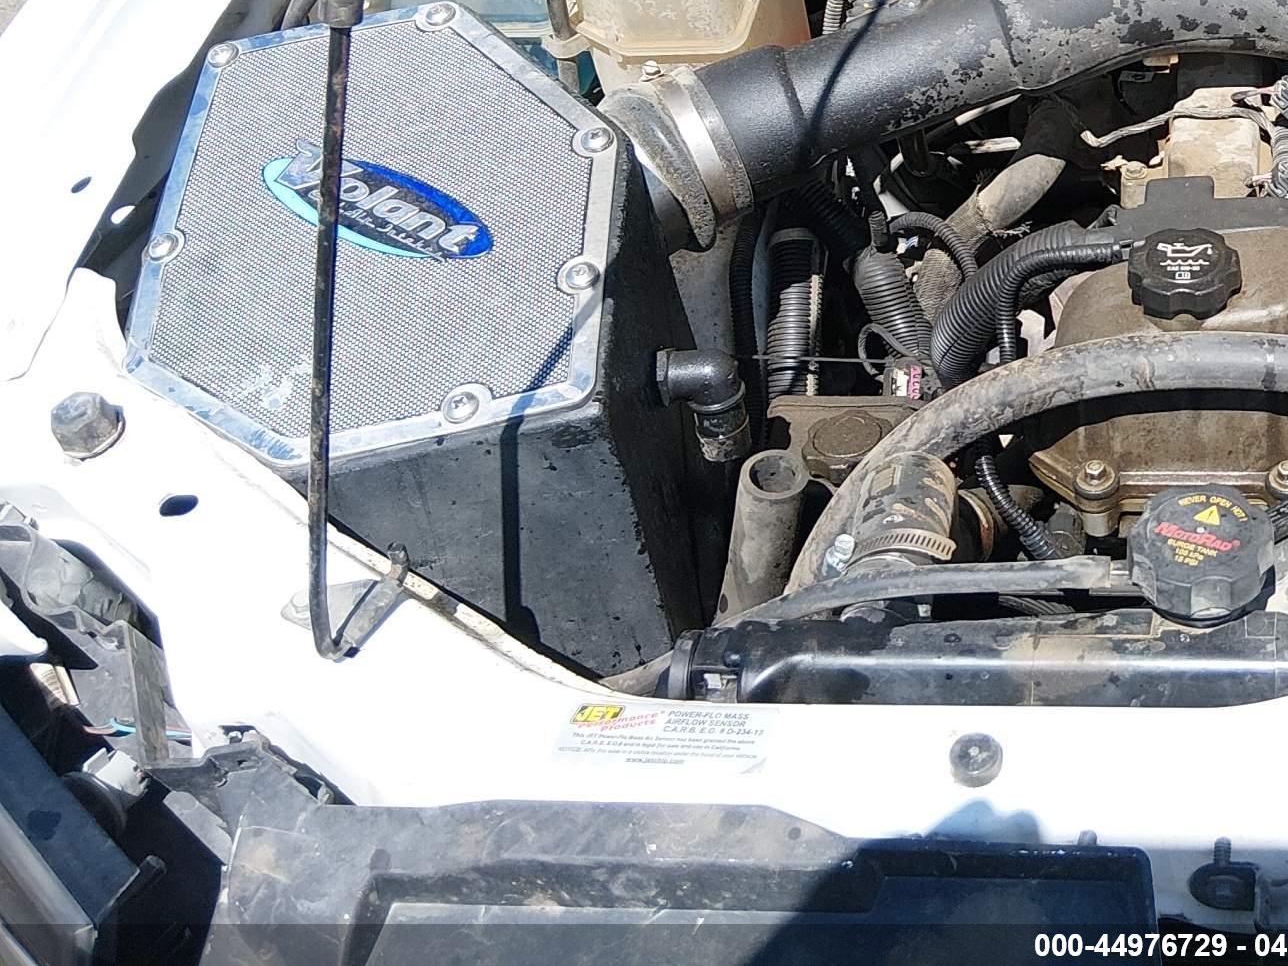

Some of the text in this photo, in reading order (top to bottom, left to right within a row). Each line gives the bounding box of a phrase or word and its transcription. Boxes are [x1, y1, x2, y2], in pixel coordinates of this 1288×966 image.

[1178, 495, 1249, 522] NEVER OPEN HOT!
[1197, 545, 1218, 558] TANK
[575, 706, 622, 722] JET
[667, 710, 750, 721] POWER-FLO MASS
[664, 718, 747, 727] AIRFLOW SENSOR
